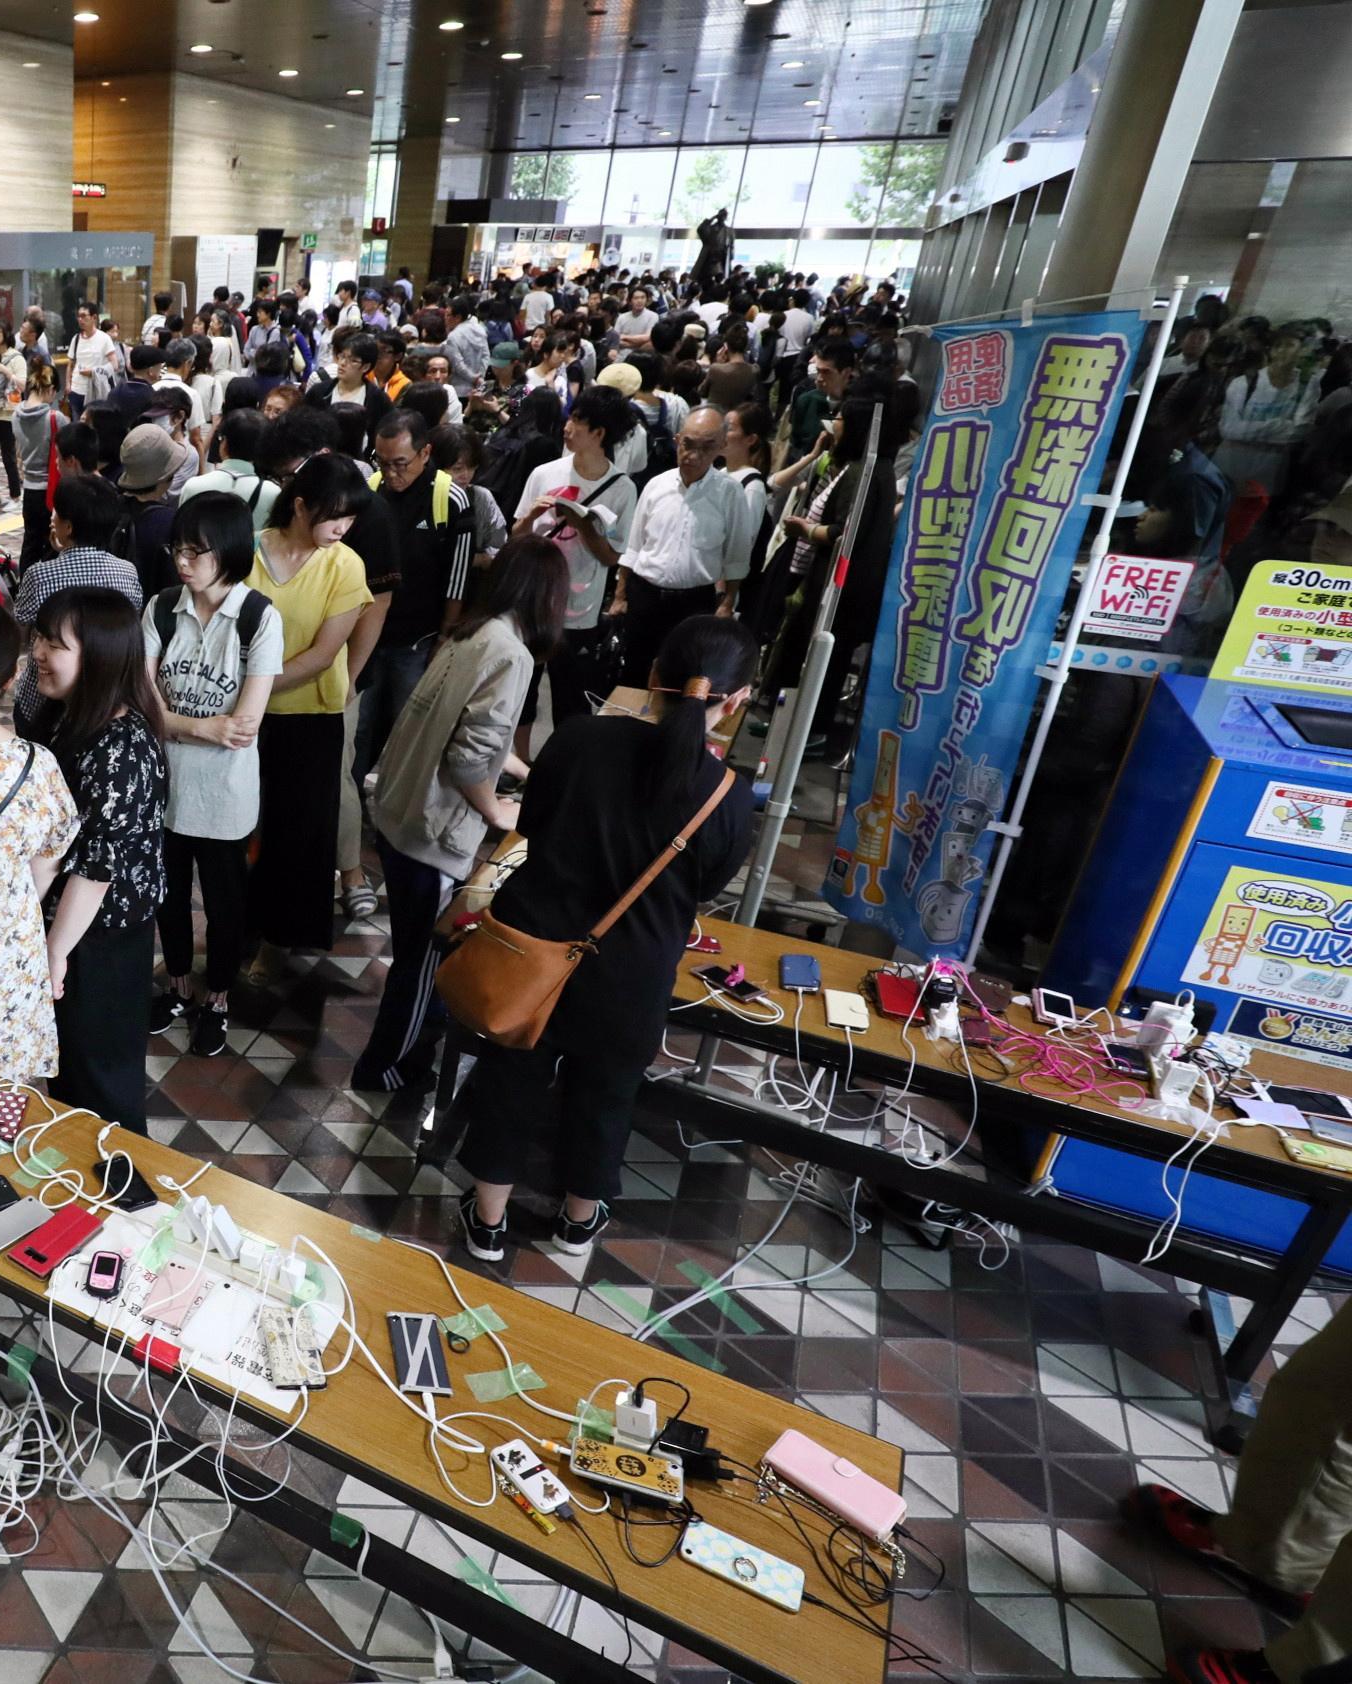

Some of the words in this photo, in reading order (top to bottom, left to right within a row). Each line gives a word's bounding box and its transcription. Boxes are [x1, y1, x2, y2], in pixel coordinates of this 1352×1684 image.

[1104, 565, 1181, 592] FREE
[1100, 589, 1172, 618] Wi-Fi
[1244, 882, 1328, 913] 使用済み
[1237, 983, 1352, 1014] リサイクルにご協力あり
[1293, 1036, 1349, 1053] プロジェクト
